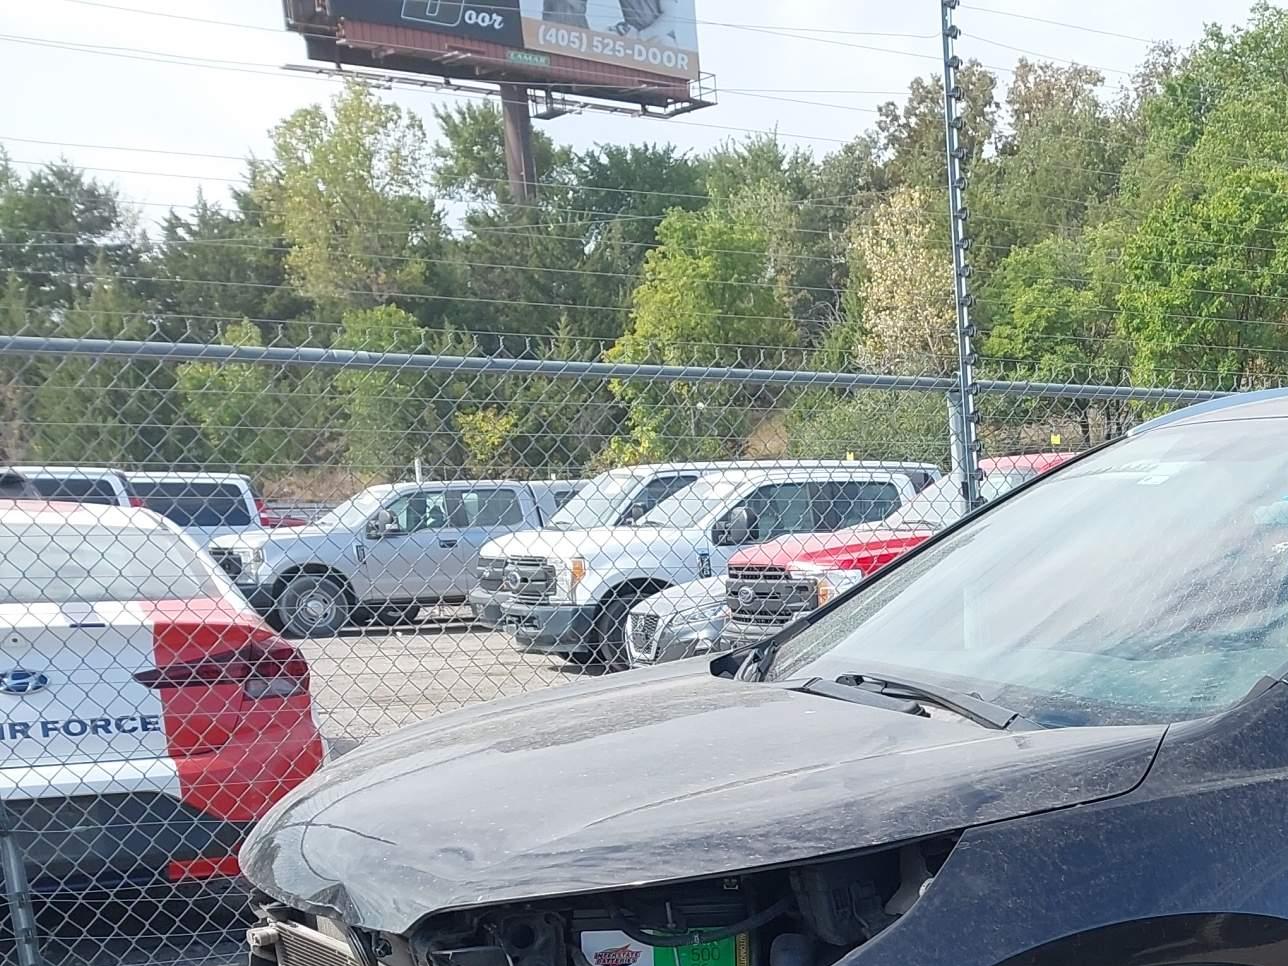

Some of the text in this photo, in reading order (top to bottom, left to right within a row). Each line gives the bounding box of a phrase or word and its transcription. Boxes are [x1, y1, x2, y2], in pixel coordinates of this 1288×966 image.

[538, 24, 689, 70] (405) 525-DOOR
[510, 51, 547, 64] LAMAR
[41, 714, 161, 738] FORCE
[691, 947, 720, 961] 500
